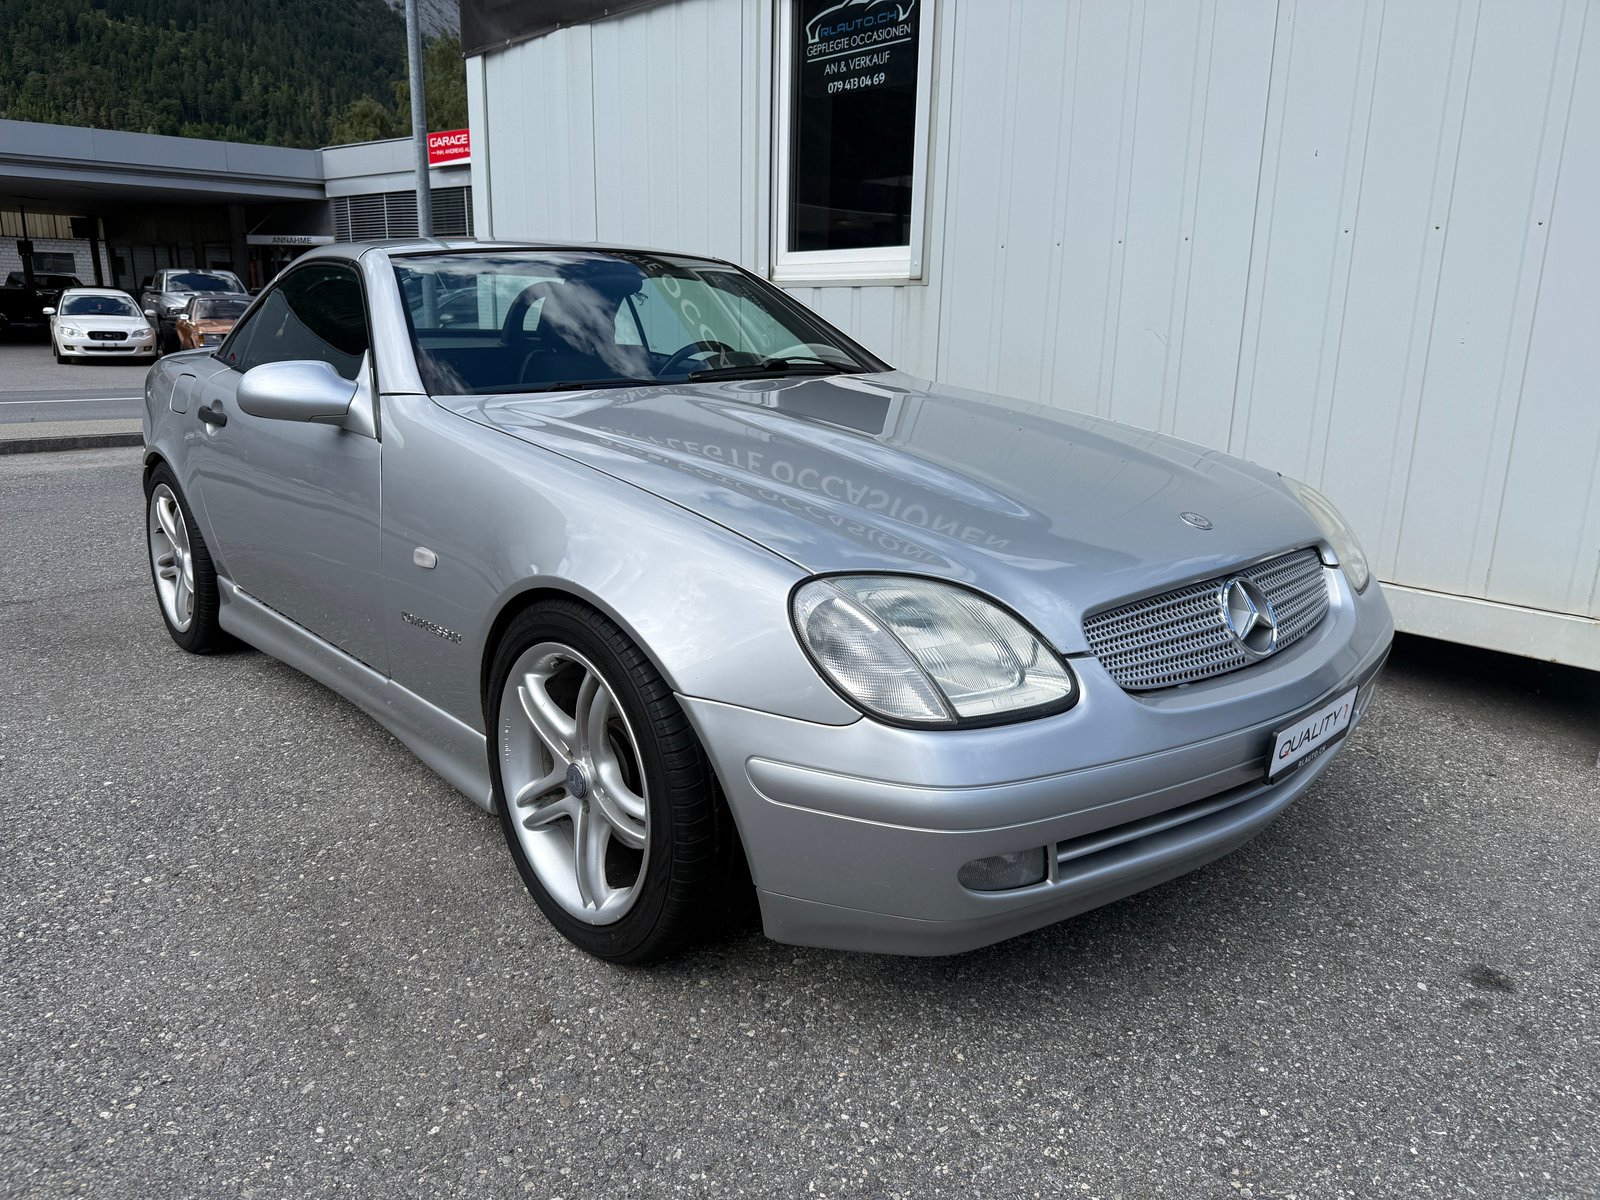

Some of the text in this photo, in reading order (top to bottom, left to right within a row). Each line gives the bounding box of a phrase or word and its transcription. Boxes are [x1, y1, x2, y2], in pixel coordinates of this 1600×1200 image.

[820, 10, 898, 37] RLAUTO.CH
[807, 23, 911, 57] GEPFLEGTE OCCASIONEN
[824, 50, 891, 76] AN & VERKAUF
[828, 72, 885, 94] 079 413 04 69
[430, 134, 468, 147] GARAGE
[272, 236, 312, 244] ANNAHME
[1279, 703, 1349, 760] QUALITY 1
